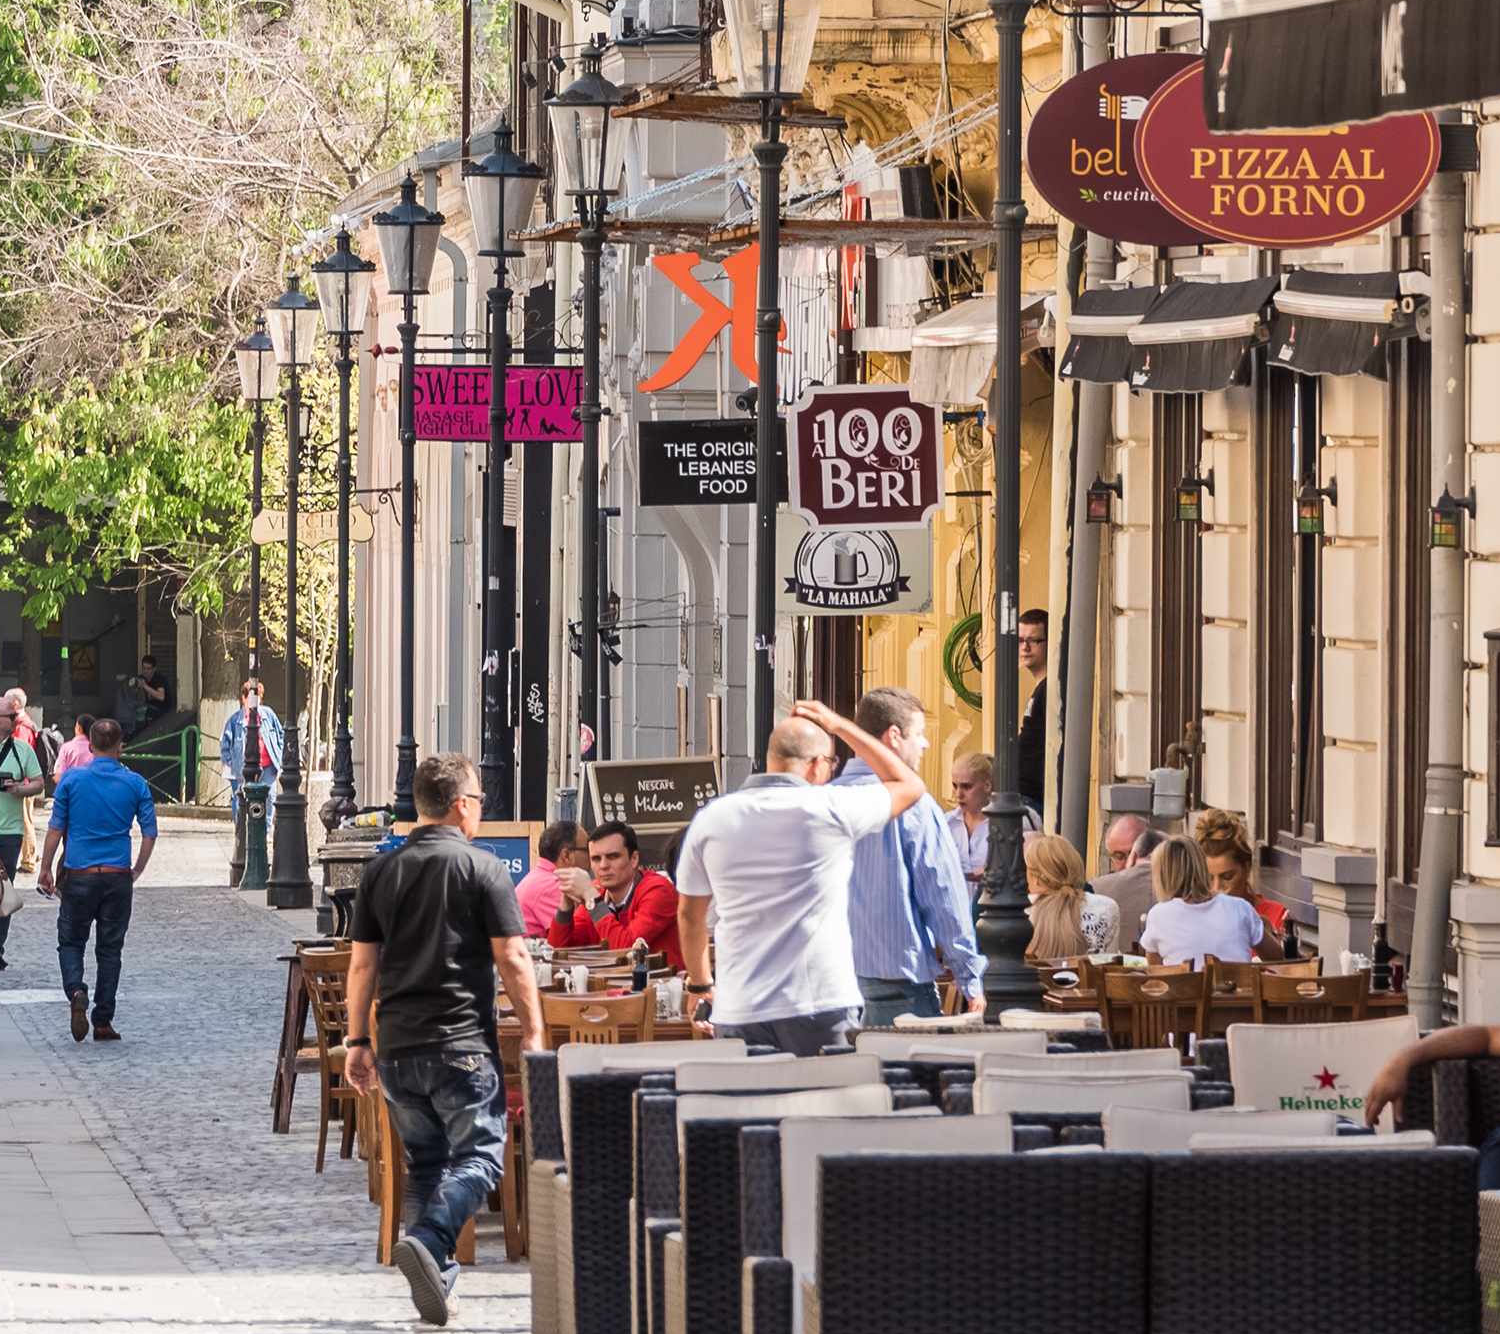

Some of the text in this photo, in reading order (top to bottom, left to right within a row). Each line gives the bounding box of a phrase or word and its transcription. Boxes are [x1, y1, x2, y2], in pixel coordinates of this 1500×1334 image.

[1190, 148, 1385, 181] PIZZA AL
[1210, 185, 1366, 217] FORNO
[815, 407, 923, 470] 100 DE
[664, 443, 698, 458] THE
[678, 461, 757, 476] LEBANES
[699, 480, 748, 494] FOOD
[820, 458, 922, 510] BERI
[634, 792, 684, 814] Milano
[1279, 1094, 1367, 1111] Heineke
